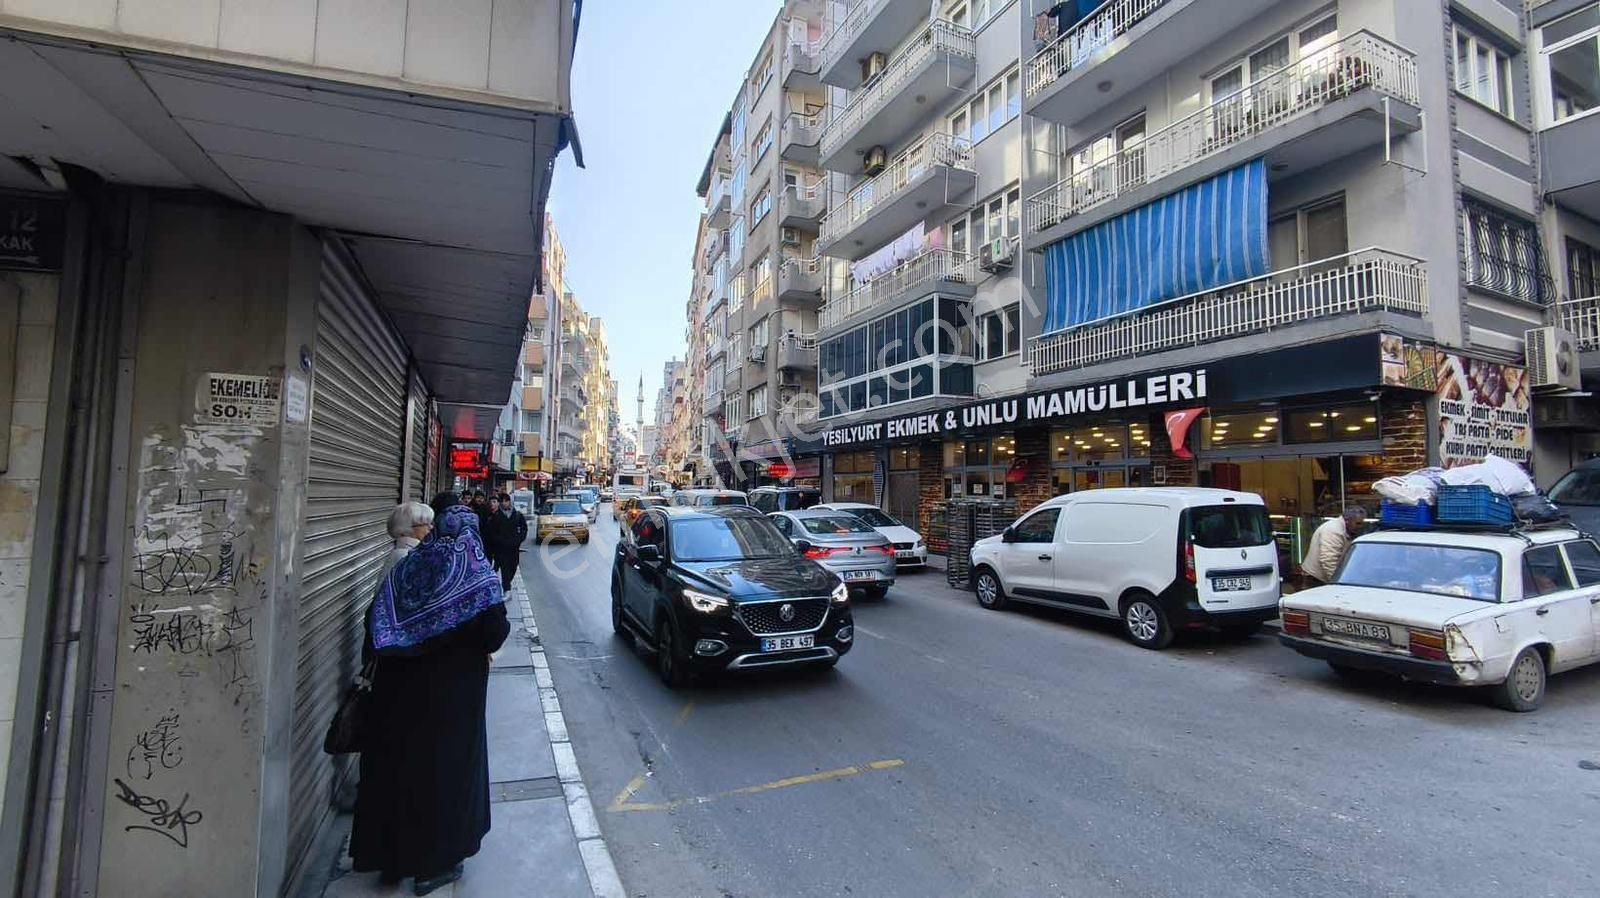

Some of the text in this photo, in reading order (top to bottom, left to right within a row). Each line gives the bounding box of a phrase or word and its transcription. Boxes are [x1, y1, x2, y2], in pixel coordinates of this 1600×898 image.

[887, 413, 940, 438] EKMEK
[944, 410, 957, 430] &
[963, 400, 1018, 428] UNLU
[1027, 369, 1207, 420] MAMÜLLERİ
[1440, 401, 1466, 417] EKMEK
[1468, 424, 1490, 438] PASTA
[1446, 441, 1465, 456] KURU
[1466, 443, 1488, 457] PASTA
[1346, 622, 1369, 636] BNA
[1371, 626, 1389, 640] 83
[766, 639, 777, 650] 35
